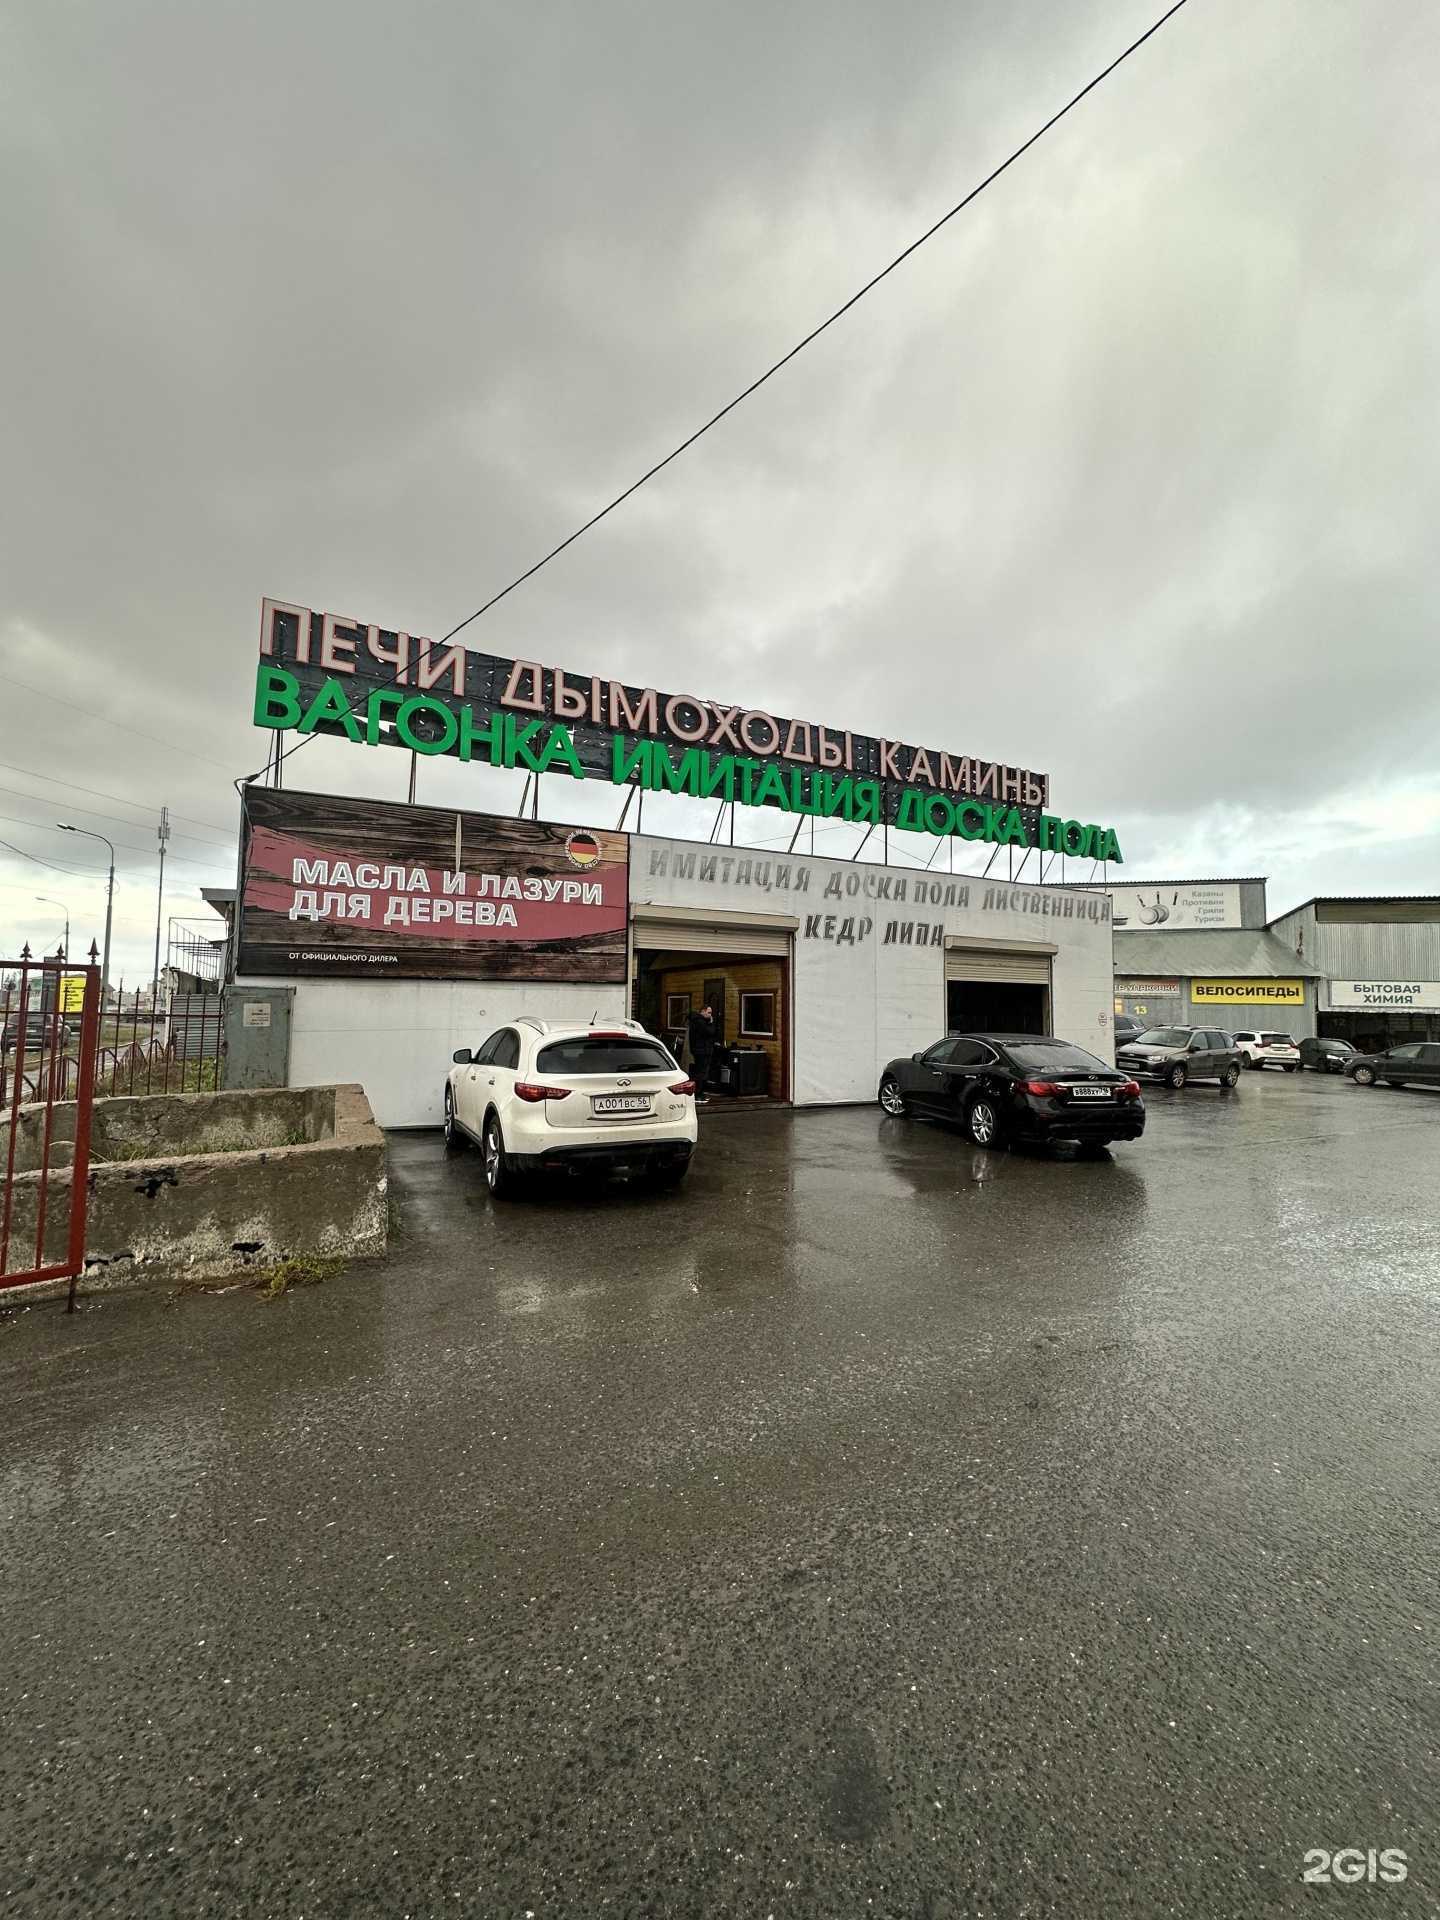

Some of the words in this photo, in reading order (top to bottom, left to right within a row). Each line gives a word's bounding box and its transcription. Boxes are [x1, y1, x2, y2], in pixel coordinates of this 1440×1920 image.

[260, 597, 466, 696] ПЕЧИ
[500, 658, 852, 770] ДЫМОХОДЫ
[880, 737, 1049, 808] КАМИНЫ
[253, 664, 585, 779] ВАГОНКА
[612, 735, 880, 824] ИМИТАЦИЯ
[895, 788, 1028, 848] ДОСКА
[1040, 814, 1124, 864] ПОЛА
[292, 858, 431, 893] МАСЛА
[442, 870, 466, 895] И
[477, 874, 603, 905] ЛАЗУРИ
[649, 849, 811, 892] ИМИТАЦИЯ
[824, 871, 906, 900] ДОСКА
[914, 880, 970, 908] ПОЛА
[982, 887, 1110, 924] ЛИСТВЕННИЦА
[288, 890, 371, 921] ДЛЯ
[383, 896, 519, 927] ДЕРЕВА
[804, 914, 873, 946] КЕДР
[884, 920, 945, 946] ЛИПА
[289, 952, 300, 960] ОТ
[302, 952, 367, 962] ОФИЦИАЛЬНОГО
[368, 954, 398, 963] ДИЛЕРА
[1196, 986, 1300, 999] ВЕЛОСИПЕДЫ
[1353, 984, 1421, 993] БЫТОВАЯ
[1364, 994, 1413, 1004] ХИМИЯ
